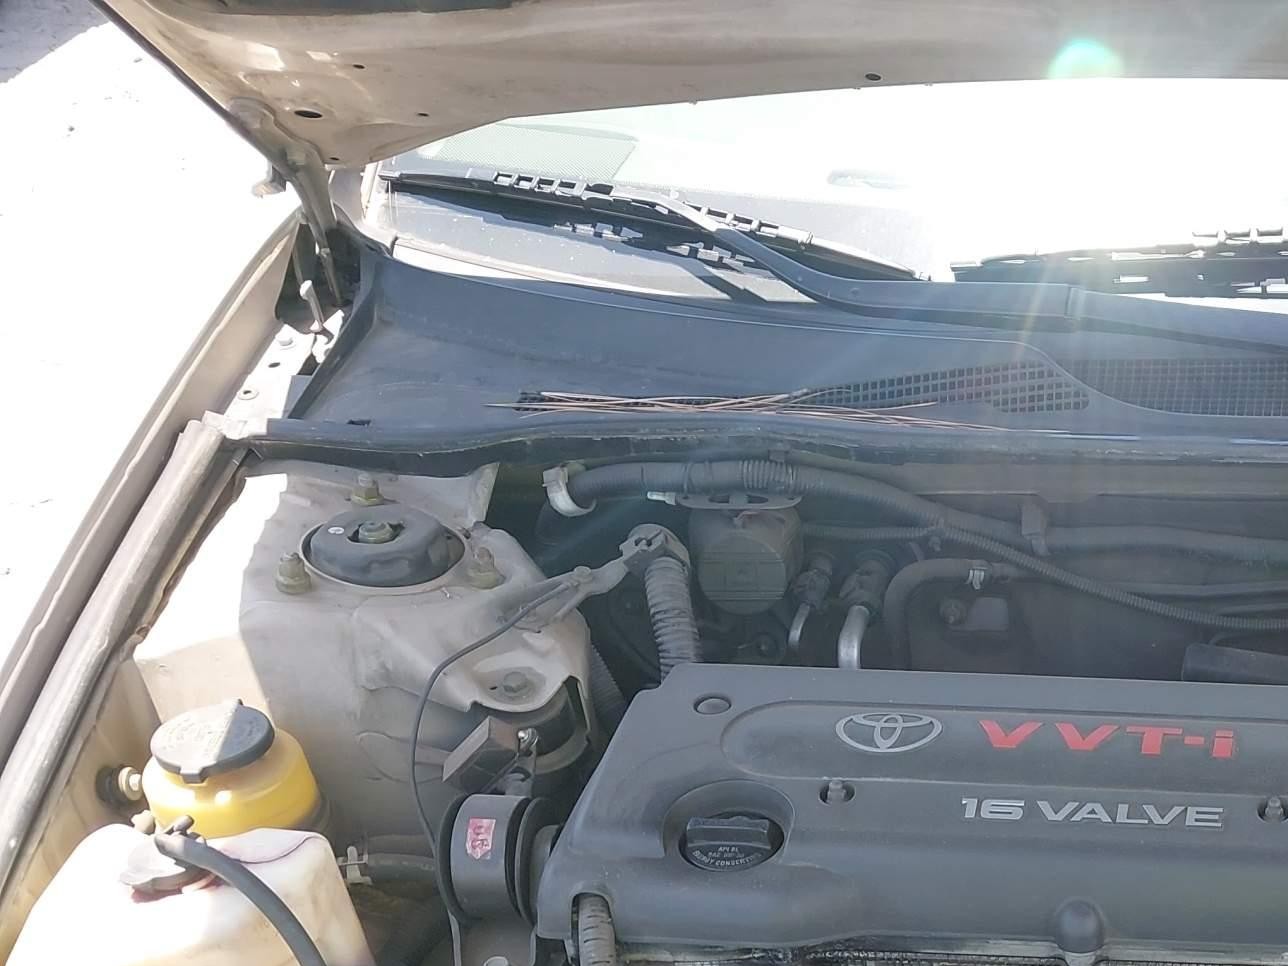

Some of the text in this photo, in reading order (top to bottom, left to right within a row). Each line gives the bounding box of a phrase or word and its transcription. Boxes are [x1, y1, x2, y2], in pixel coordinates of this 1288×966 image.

[978, 719, 1235, 758] VVT-i
[961, 797, 1225, 828] 16 VALVE
